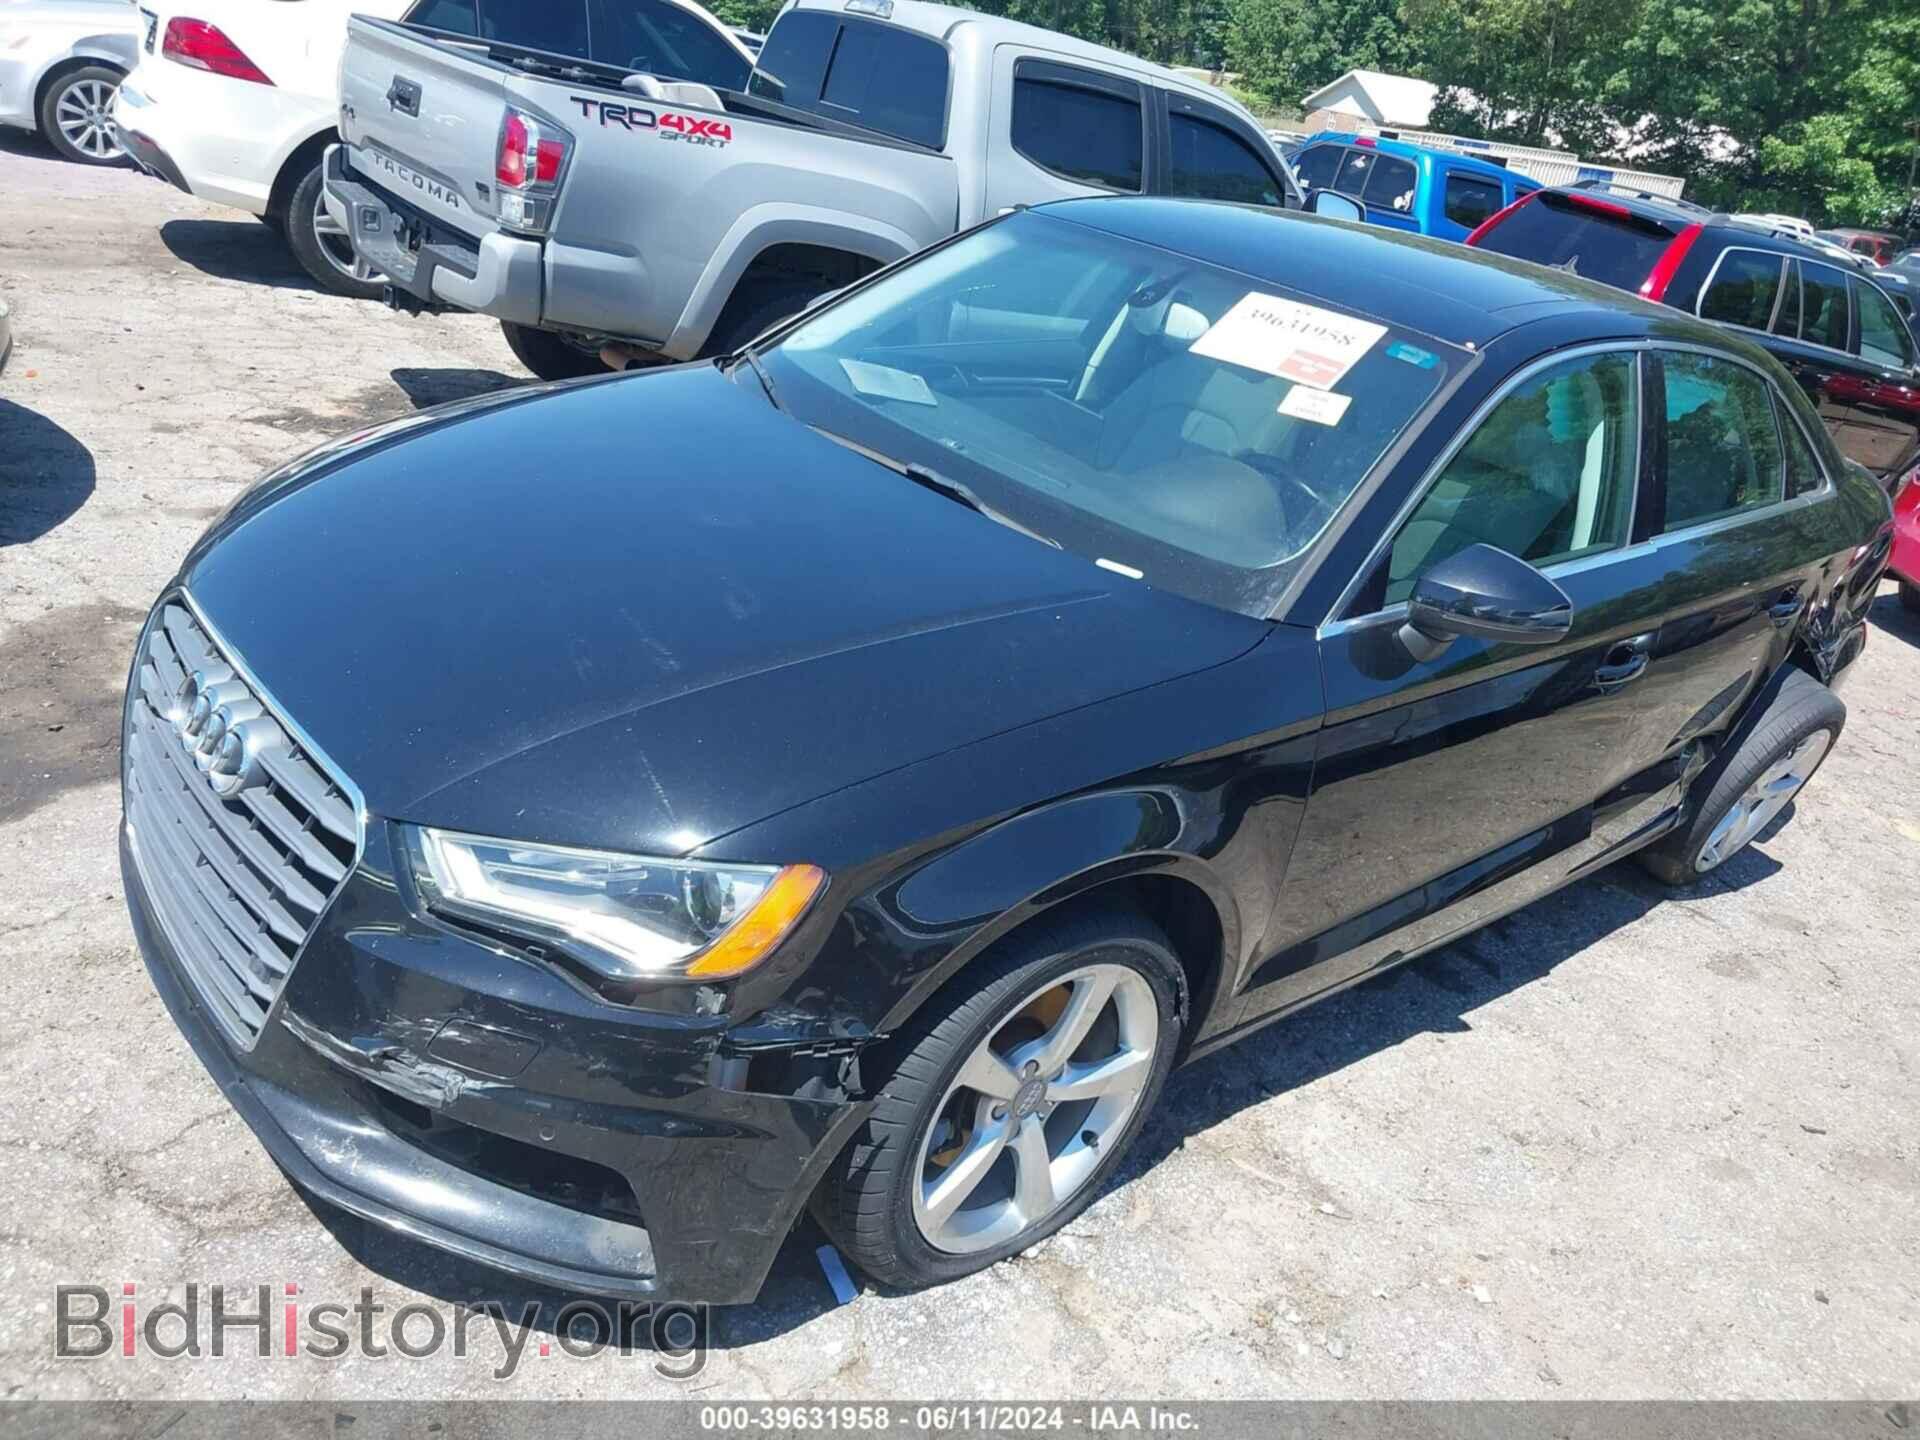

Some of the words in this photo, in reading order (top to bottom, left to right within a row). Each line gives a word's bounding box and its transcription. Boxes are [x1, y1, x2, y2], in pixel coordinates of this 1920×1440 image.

[570, 96, 658, 130] TRD
[658, 130, 729, 149] SPORT
[373, 152, 460, 208] TACOMA
